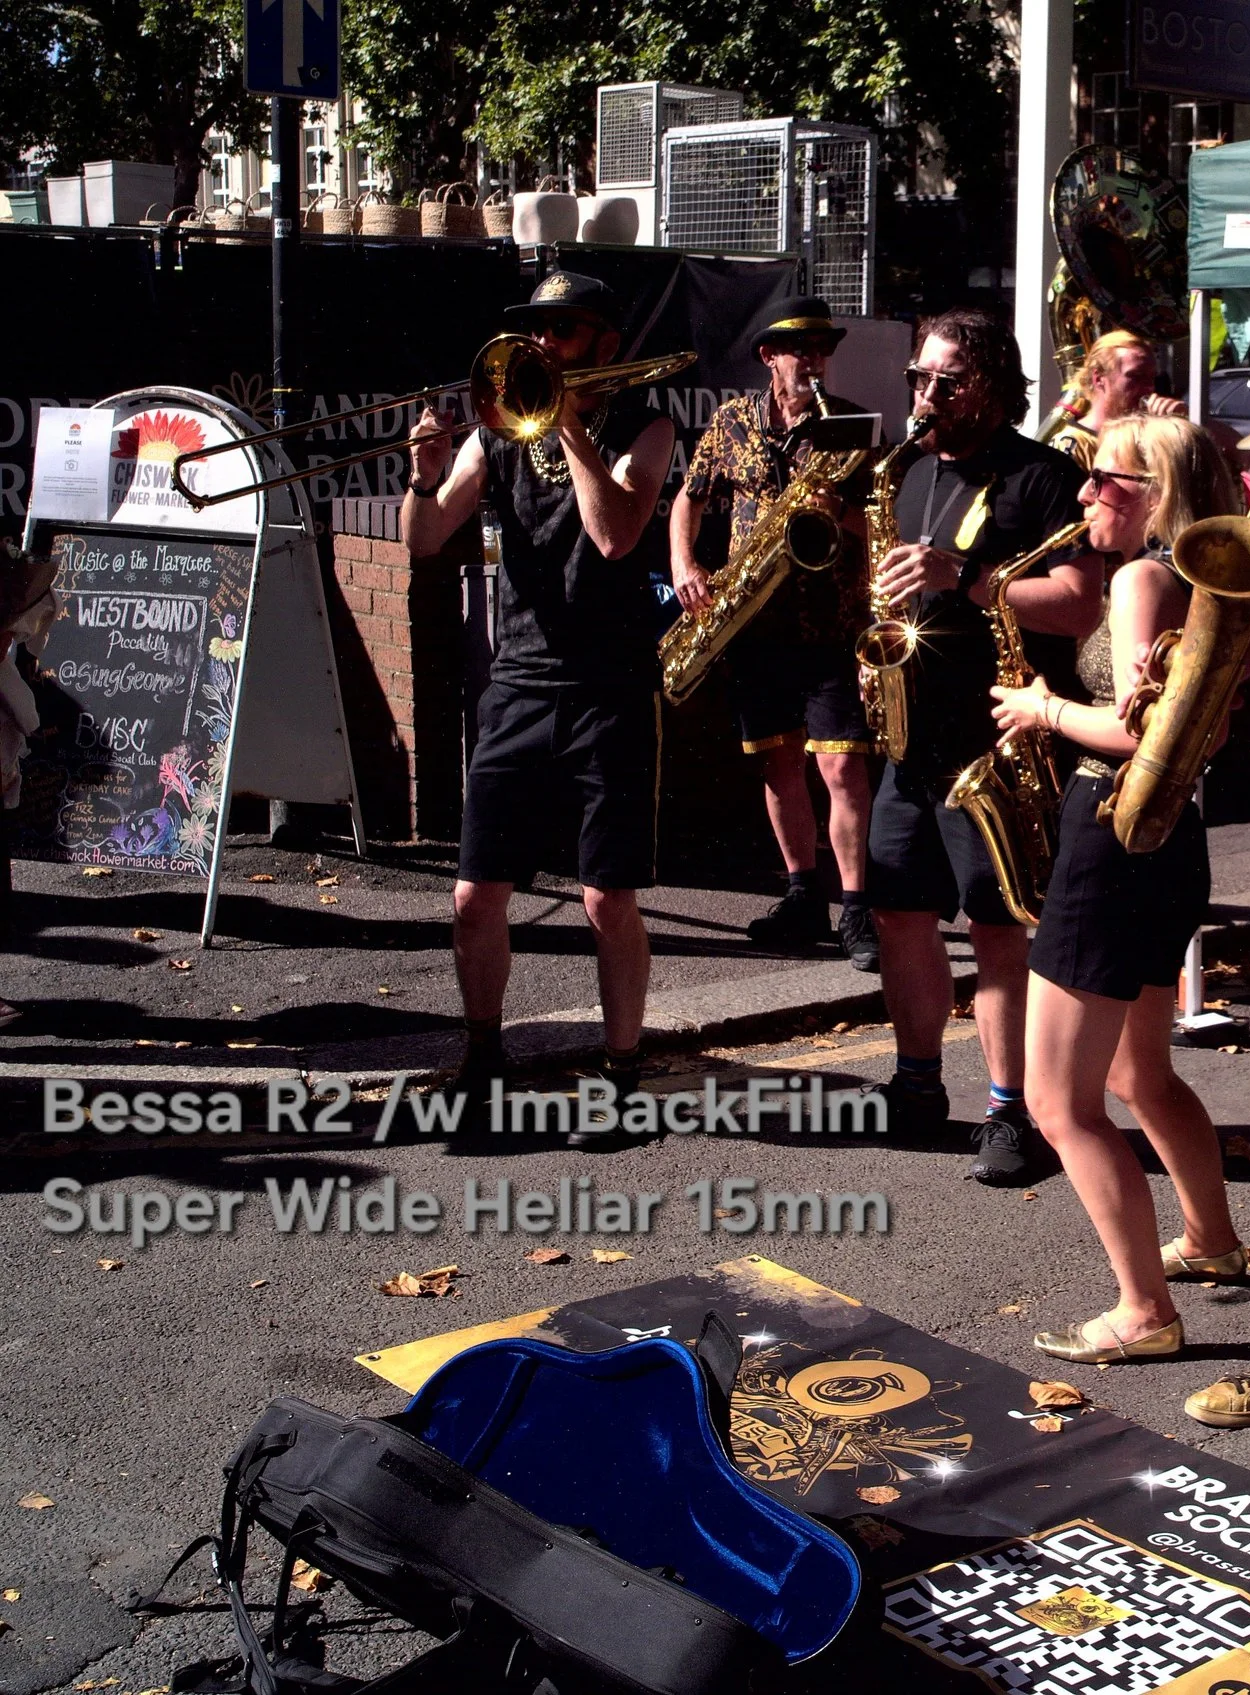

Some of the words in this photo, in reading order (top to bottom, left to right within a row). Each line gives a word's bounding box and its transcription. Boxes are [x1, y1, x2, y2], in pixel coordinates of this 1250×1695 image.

[111, 489, 149, 506] FLOWER
[155, 493, 192, 509] MARKE
[60, 543, 110, 572] Music
[112, 553, 126, 573] @
[130, 549, 149, 571] the
[78, 597, 198, 633] WESTBOUND
